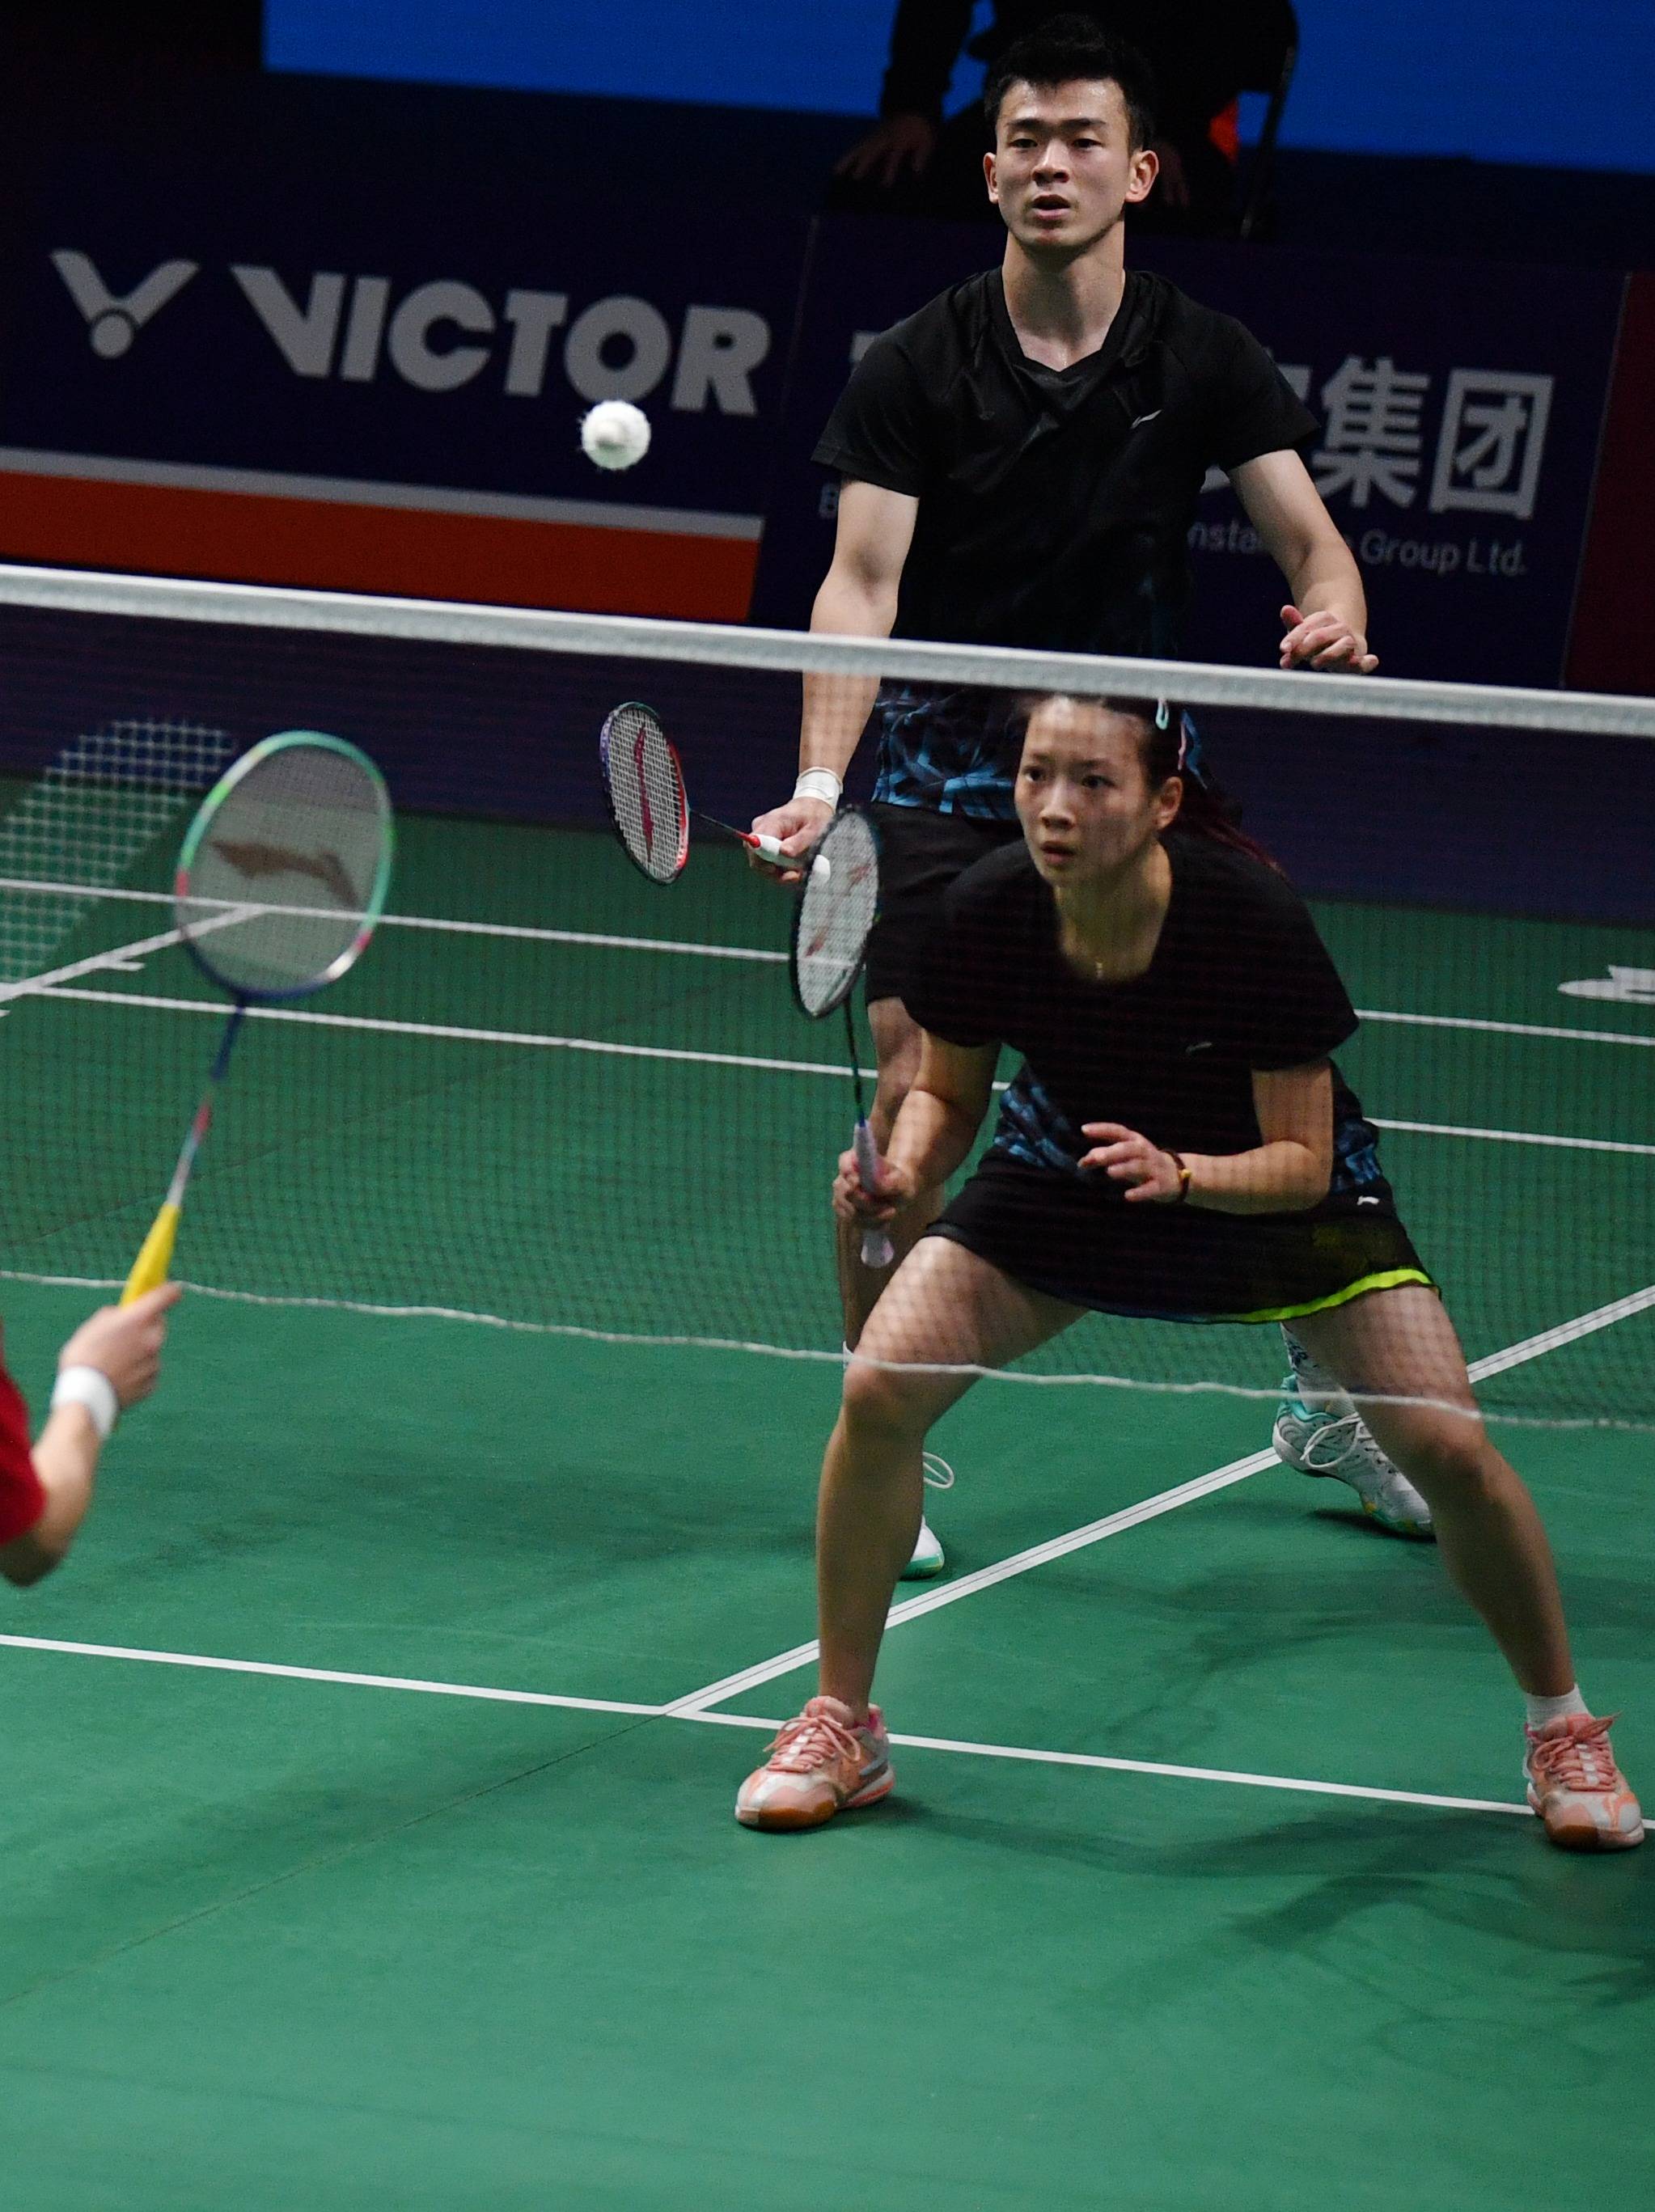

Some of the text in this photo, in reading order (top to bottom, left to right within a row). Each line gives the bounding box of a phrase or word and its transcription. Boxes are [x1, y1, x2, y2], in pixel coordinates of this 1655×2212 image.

[230, 264, 771, 416] VICTOR
[1199, 348, 1554, 520] 集团
[1360, 528, 1459, 577] Group
